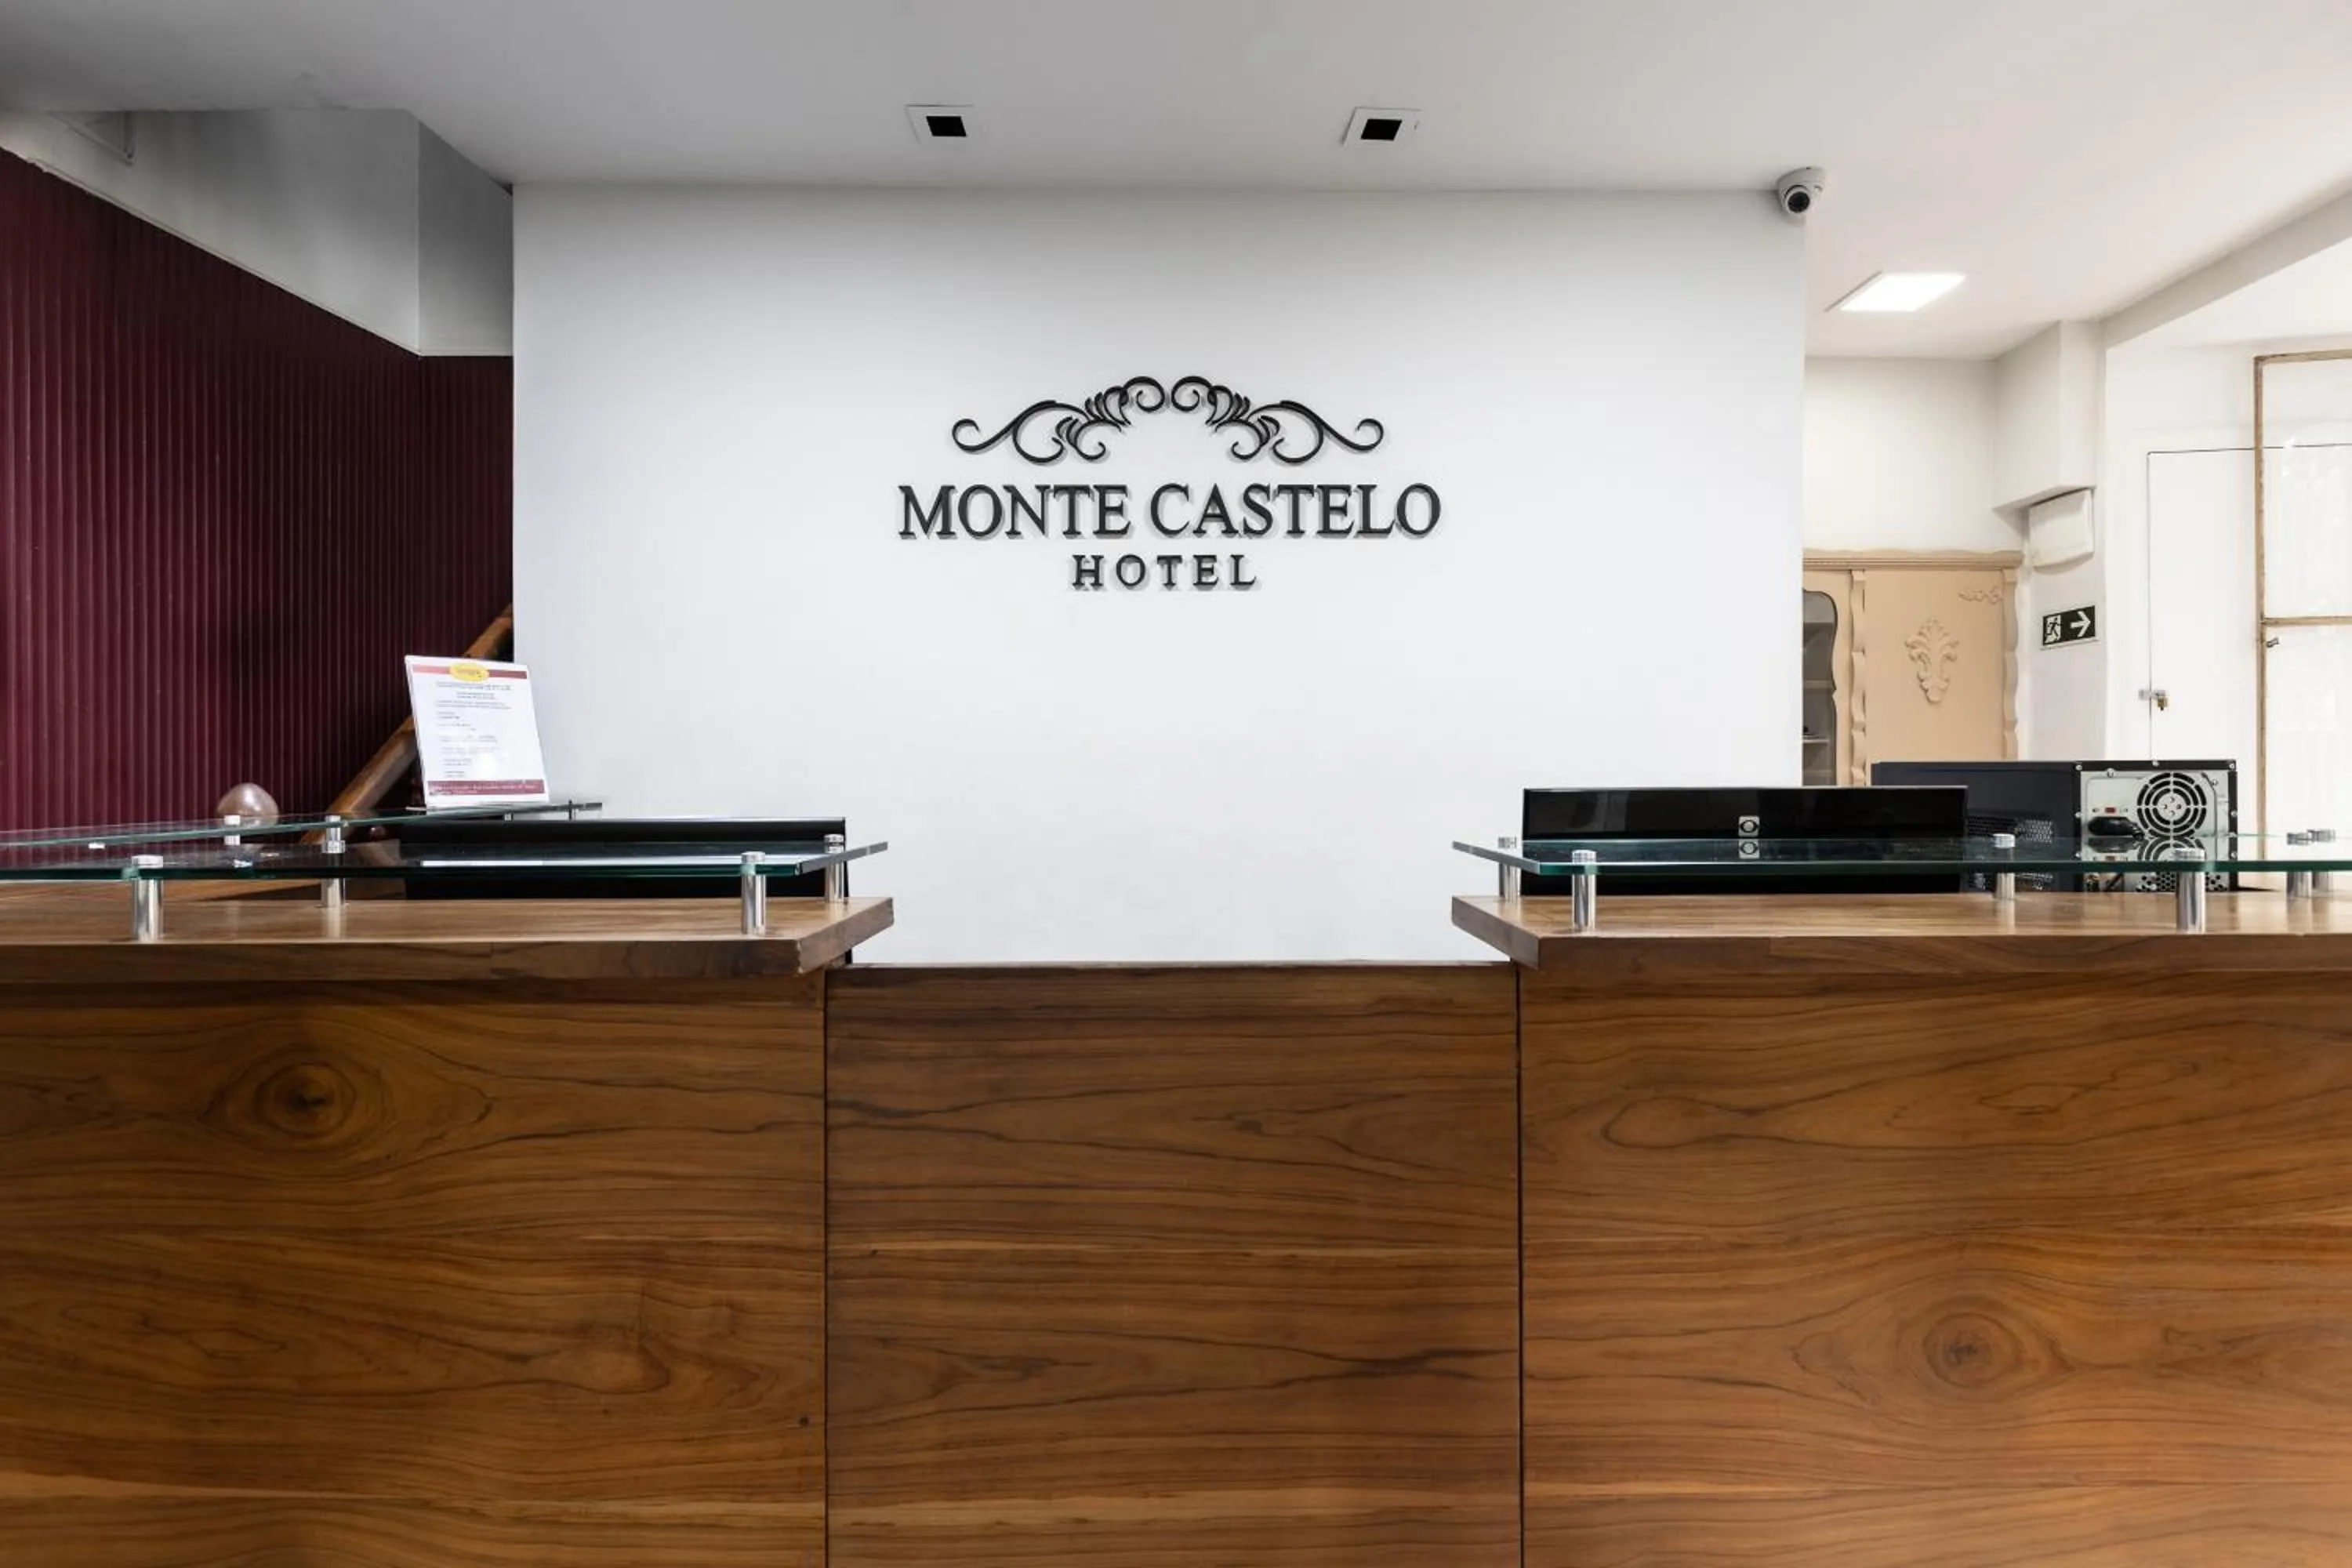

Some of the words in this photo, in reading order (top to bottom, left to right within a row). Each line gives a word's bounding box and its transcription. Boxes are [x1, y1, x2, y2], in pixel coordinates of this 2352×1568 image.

[898, 484, 1131, 539] MONTE
[1150, 483, 1441, 538] CASTELO
[1072, 554, 1255, 590] HOTEL
